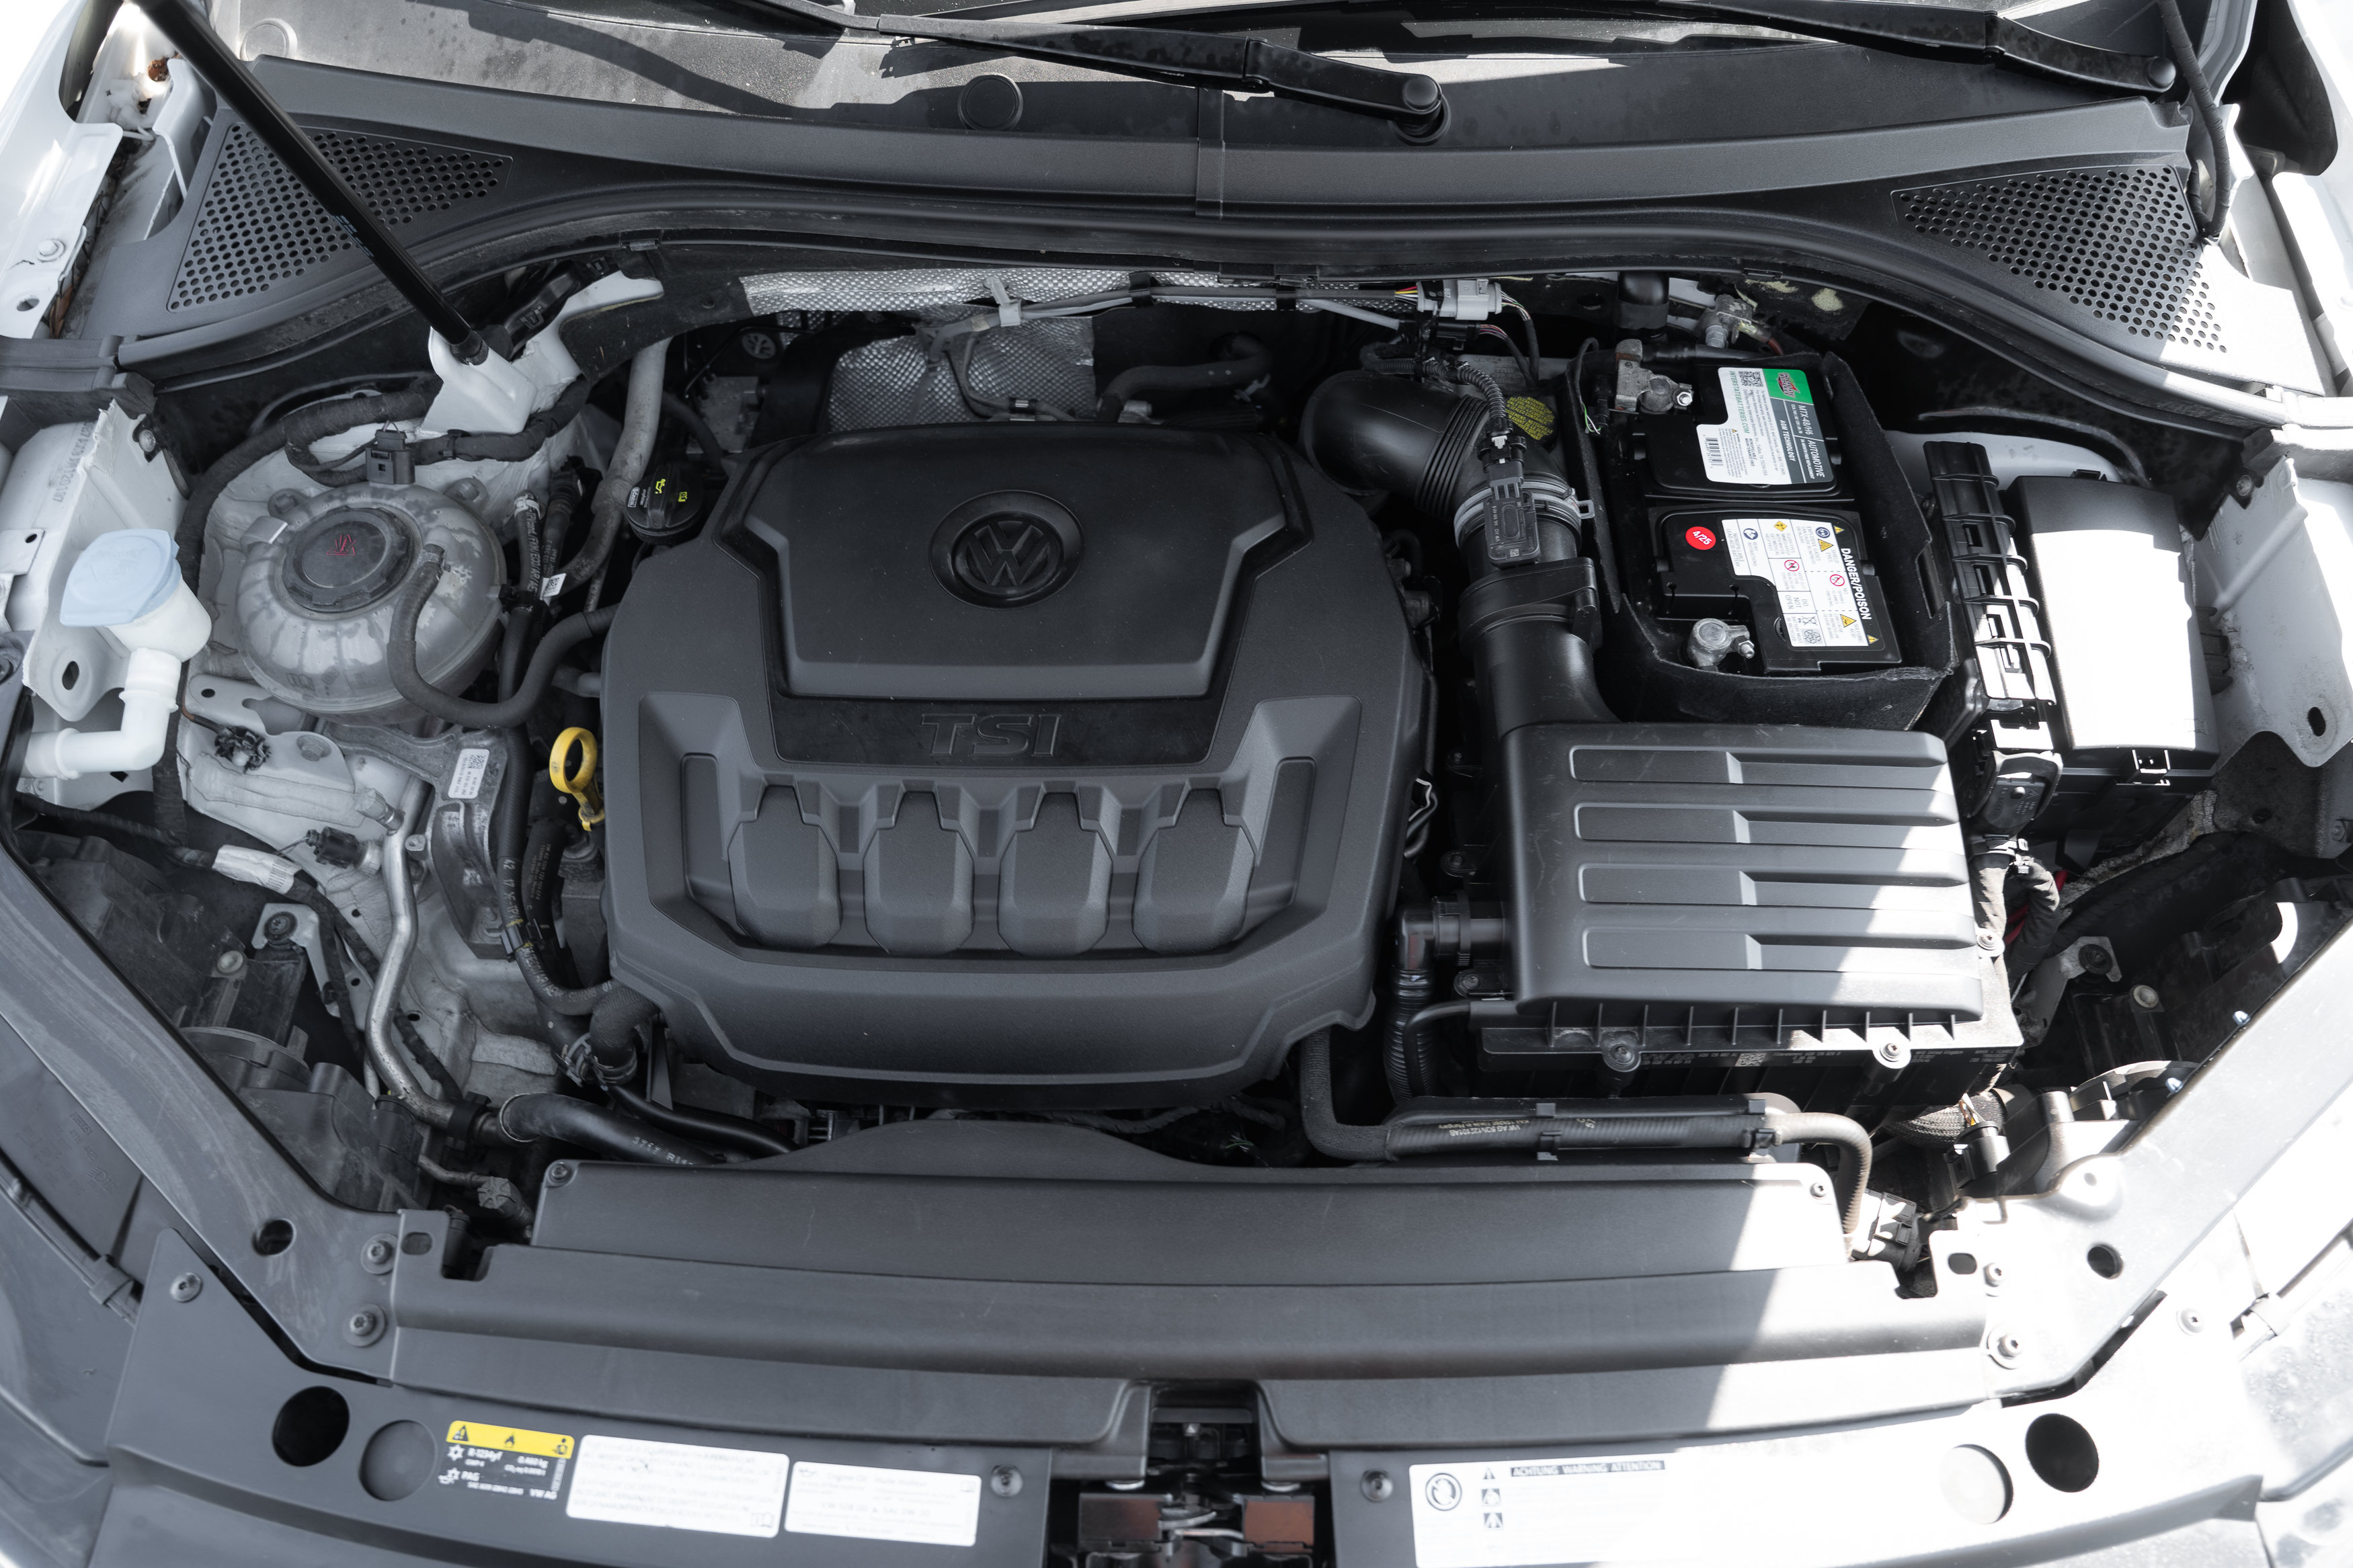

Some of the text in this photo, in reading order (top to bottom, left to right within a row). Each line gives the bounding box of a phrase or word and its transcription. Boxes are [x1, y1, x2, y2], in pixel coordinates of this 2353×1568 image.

[1728, 370, 1750, 434] INTERSTATEBATTERIES.COM
[1797, 405, 1813, 435] MTX-48/H6
[1779, 419, 1796, 462] AGM TECHNOLOGY
[1806, 440, 1825, 478] AUTOMOTIVE
[1691, 530, 1712, 546] 4/25
[961, 518, 1055, 591] VW
[1840, 547, 1872, 620] DANGER/POISON
[1784, 595, 1794, 609] OPEN
[1793, 597, 1802, 608] NOT
[920, 713, 1062, 757] TSI
[460, 1470, 481, 1482] PAG
[1512, 1460, 1662, 1477] ACHTUNG WARNING ATTENTION
[528, 1487, 559, 1500] VW AG
